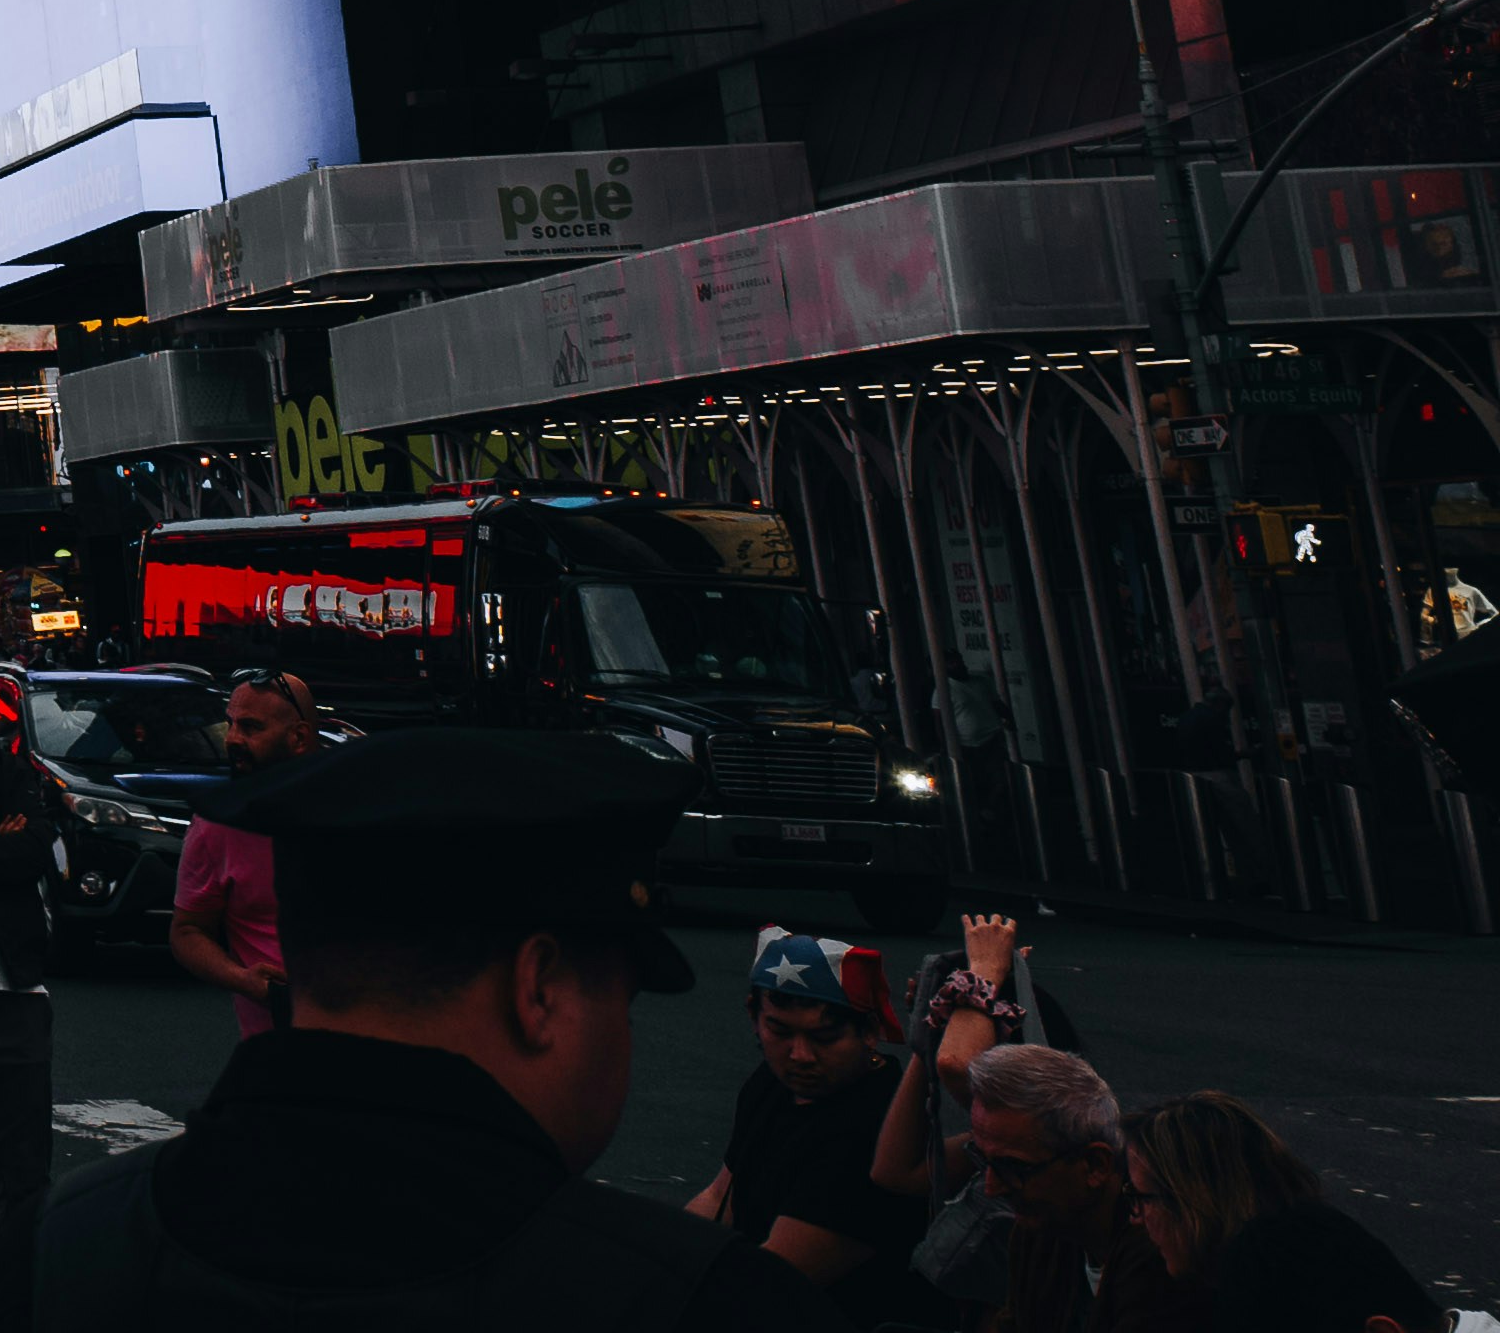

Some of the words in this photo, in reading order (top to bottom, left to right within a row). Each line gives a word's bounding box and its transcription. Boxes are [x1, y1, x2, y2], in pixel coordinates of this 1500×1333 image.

[497, 157, 633, 240] pelé
[532, 223, 611, 239] SOCCER
[1246, 363, 1267, 382] W
[1274, 361, 1300, 381] 46
[1239, 387, 1301, 405] Actors'
[1308, 386, 1362, 408] Equity
[1176, 428, 1200, 445] ONE
[1202, 426, 1221, 443] WAY
[1183, 507, 1217, 523] ONE
